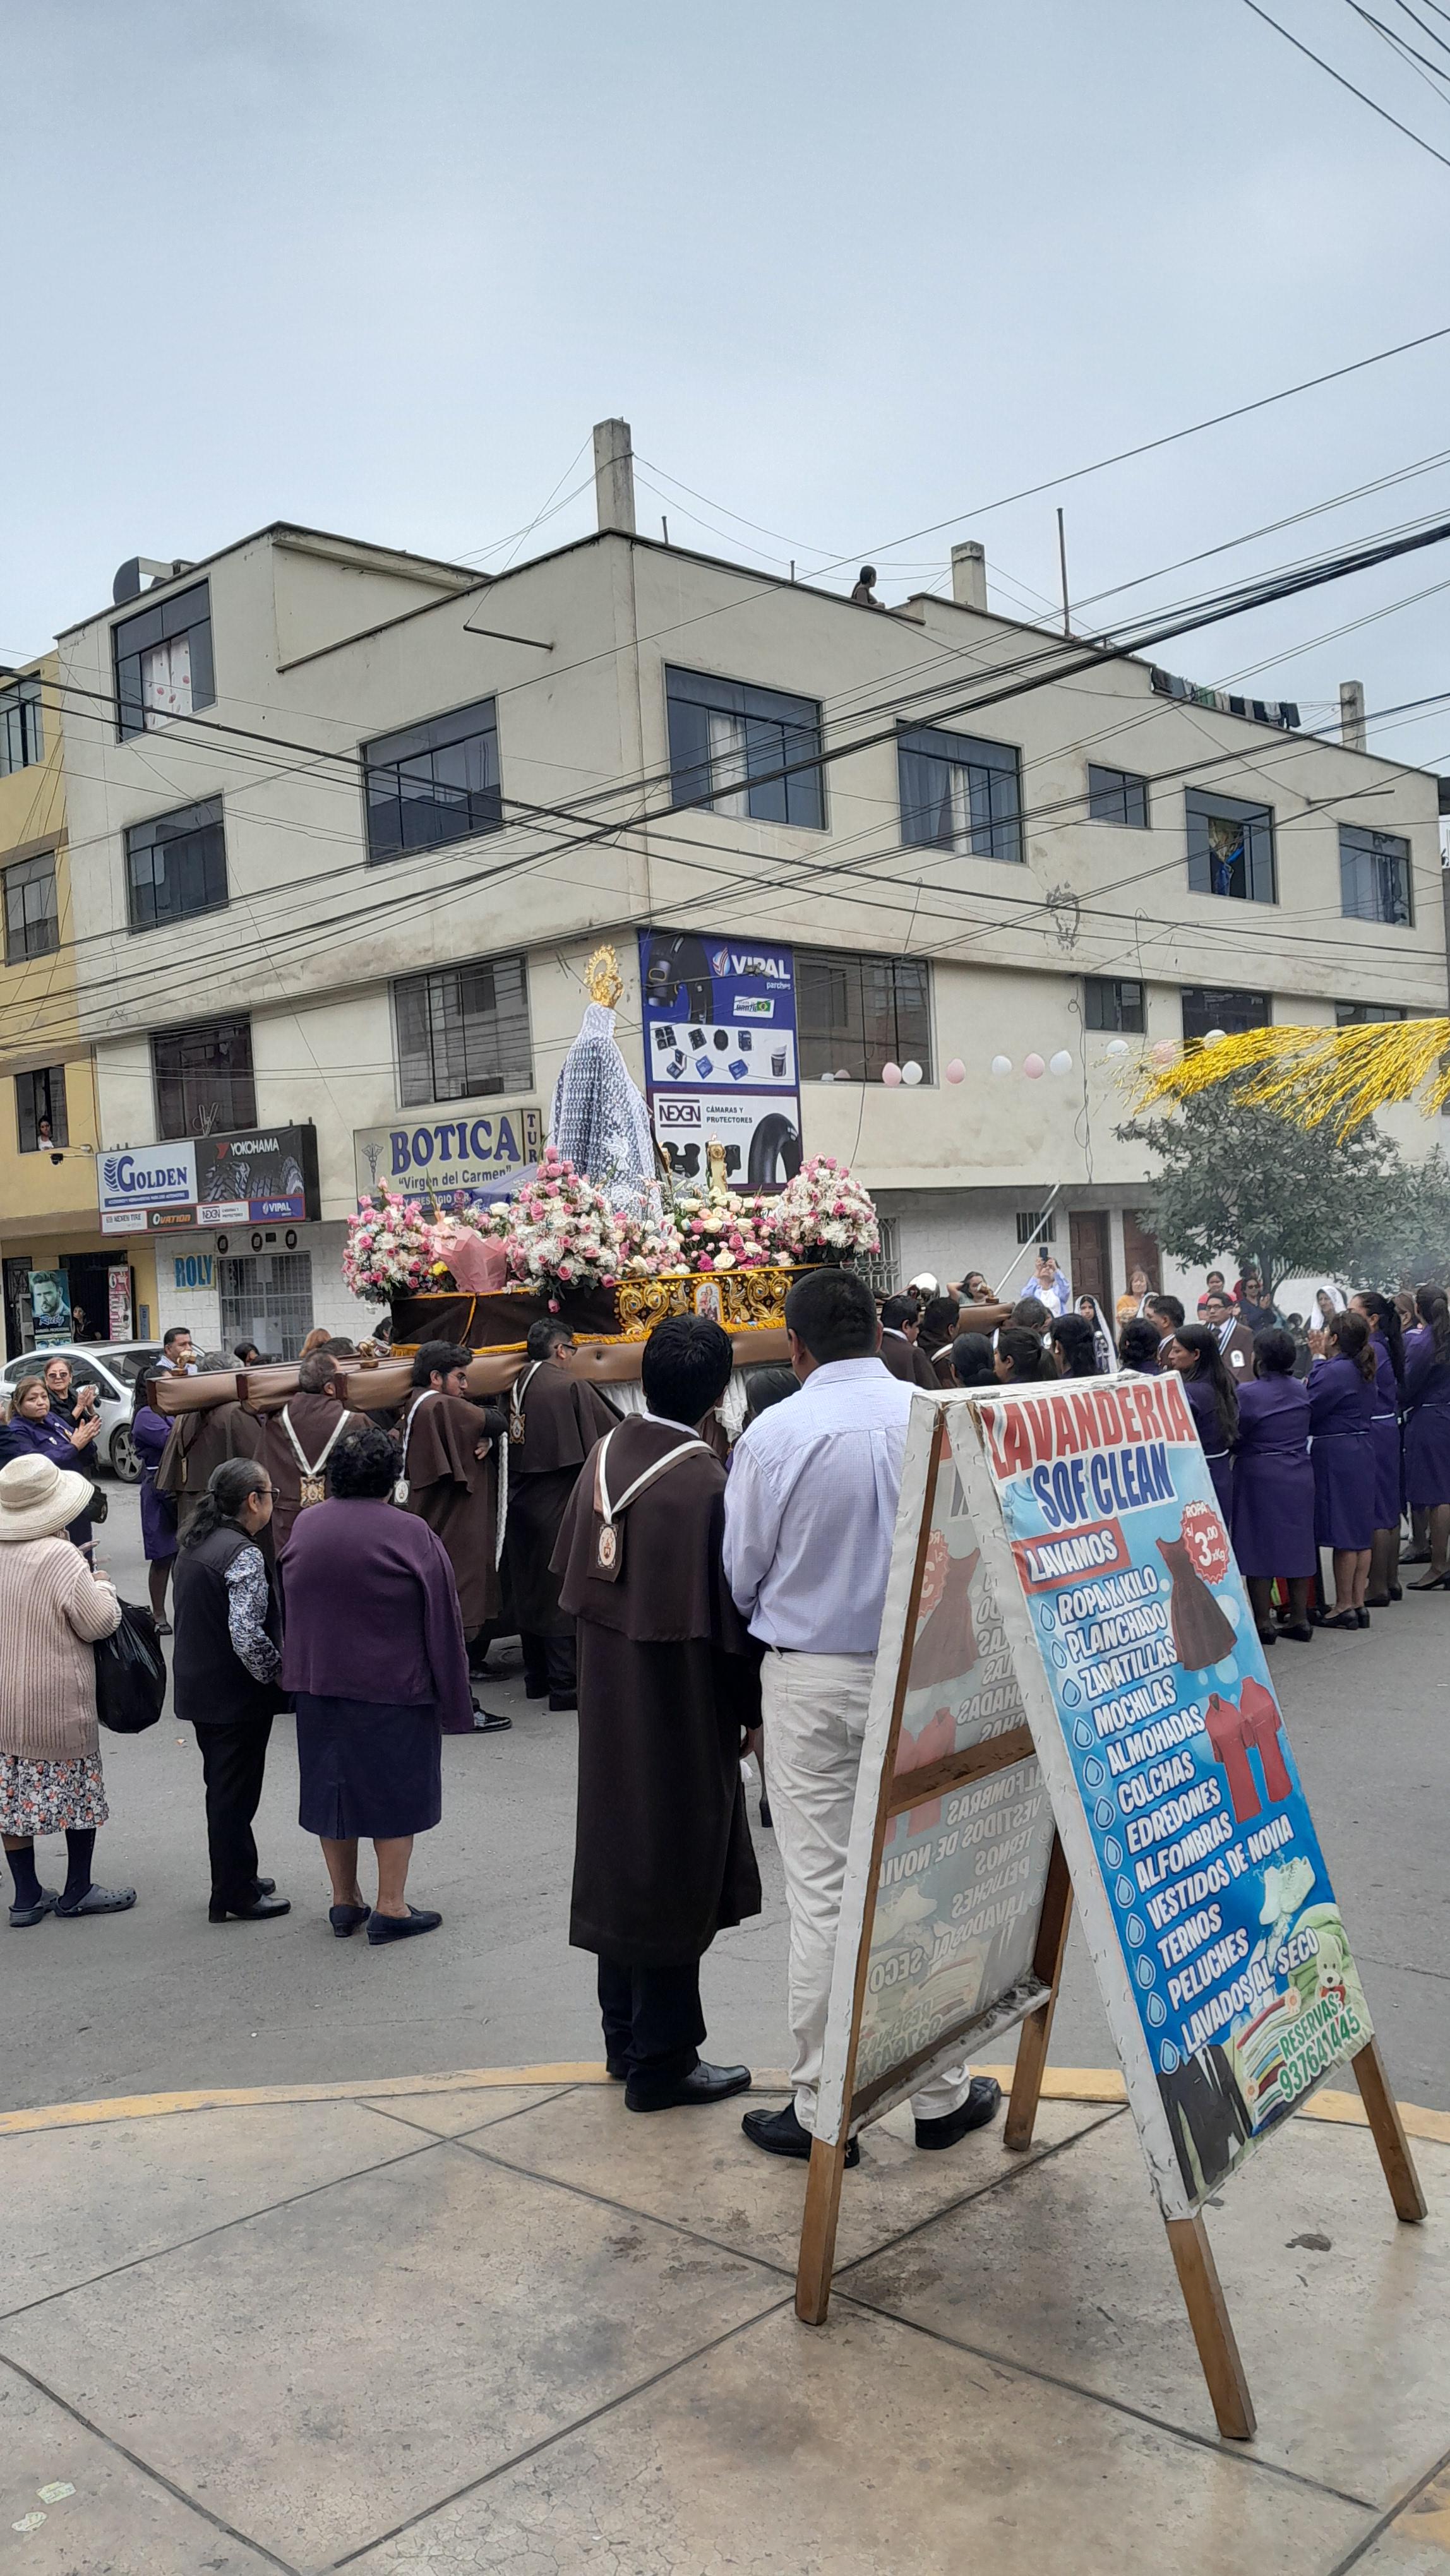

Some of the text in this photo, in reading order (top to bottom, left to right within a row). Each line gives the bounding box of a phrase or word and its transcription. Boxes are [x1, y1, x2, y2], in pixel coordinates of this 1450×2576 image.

[731, 955, 791, 979] VIPAL
[659, 1105, 702, 1122] NEXEN
[230, 1138, 280, 1157] YOKOHAMA
[390, 1116, 521, 1176] BOTICA
[269, 1202, 291, 1212] VIPAL
[441, 1171, 458, 1186] del
[174, 1254, 213, 1289] ROLY
[980, 1378, 1197, 1481] LAVANDERIA
[1033, 1442, 1176, 1528] SOF CLEAN
[1185, 1502, 1208, 1518] ROPA
[1026, 1529, 1118, 1582] LAVAMOS
[1058, 1566, 1157, 1624] ROPA X KILO
[1065, 1602, 1167, 1662] PLANCHADO
[1079, 1637, 1177, 1700] ZAPATILLAS
[1093, 1676, 1177, 1738] MOCHILAS
[1106, 1704, 1205, 1777] ALMOHADAS
[1118, 1751, 1195, 1814] COLCHAS
[1126, 1777, 1221, 1855] EDREDONES
[1135, 1811, 1233, 1893] ALFOMBRAS
[1146, 1813, 1294, 1930] VESTIDOS DE NOVIA
[1157, 1903, 1222, 1969] TERNOS
[1168, 1928, 1249, 2010] PELUCHES
[1181, 1927, 1319, 2054] LAVADOS AL SECO
[1279, 1993, 1343, 2060] RESERVAS:
[1280, 2007, 1361, 2098] 937641445
